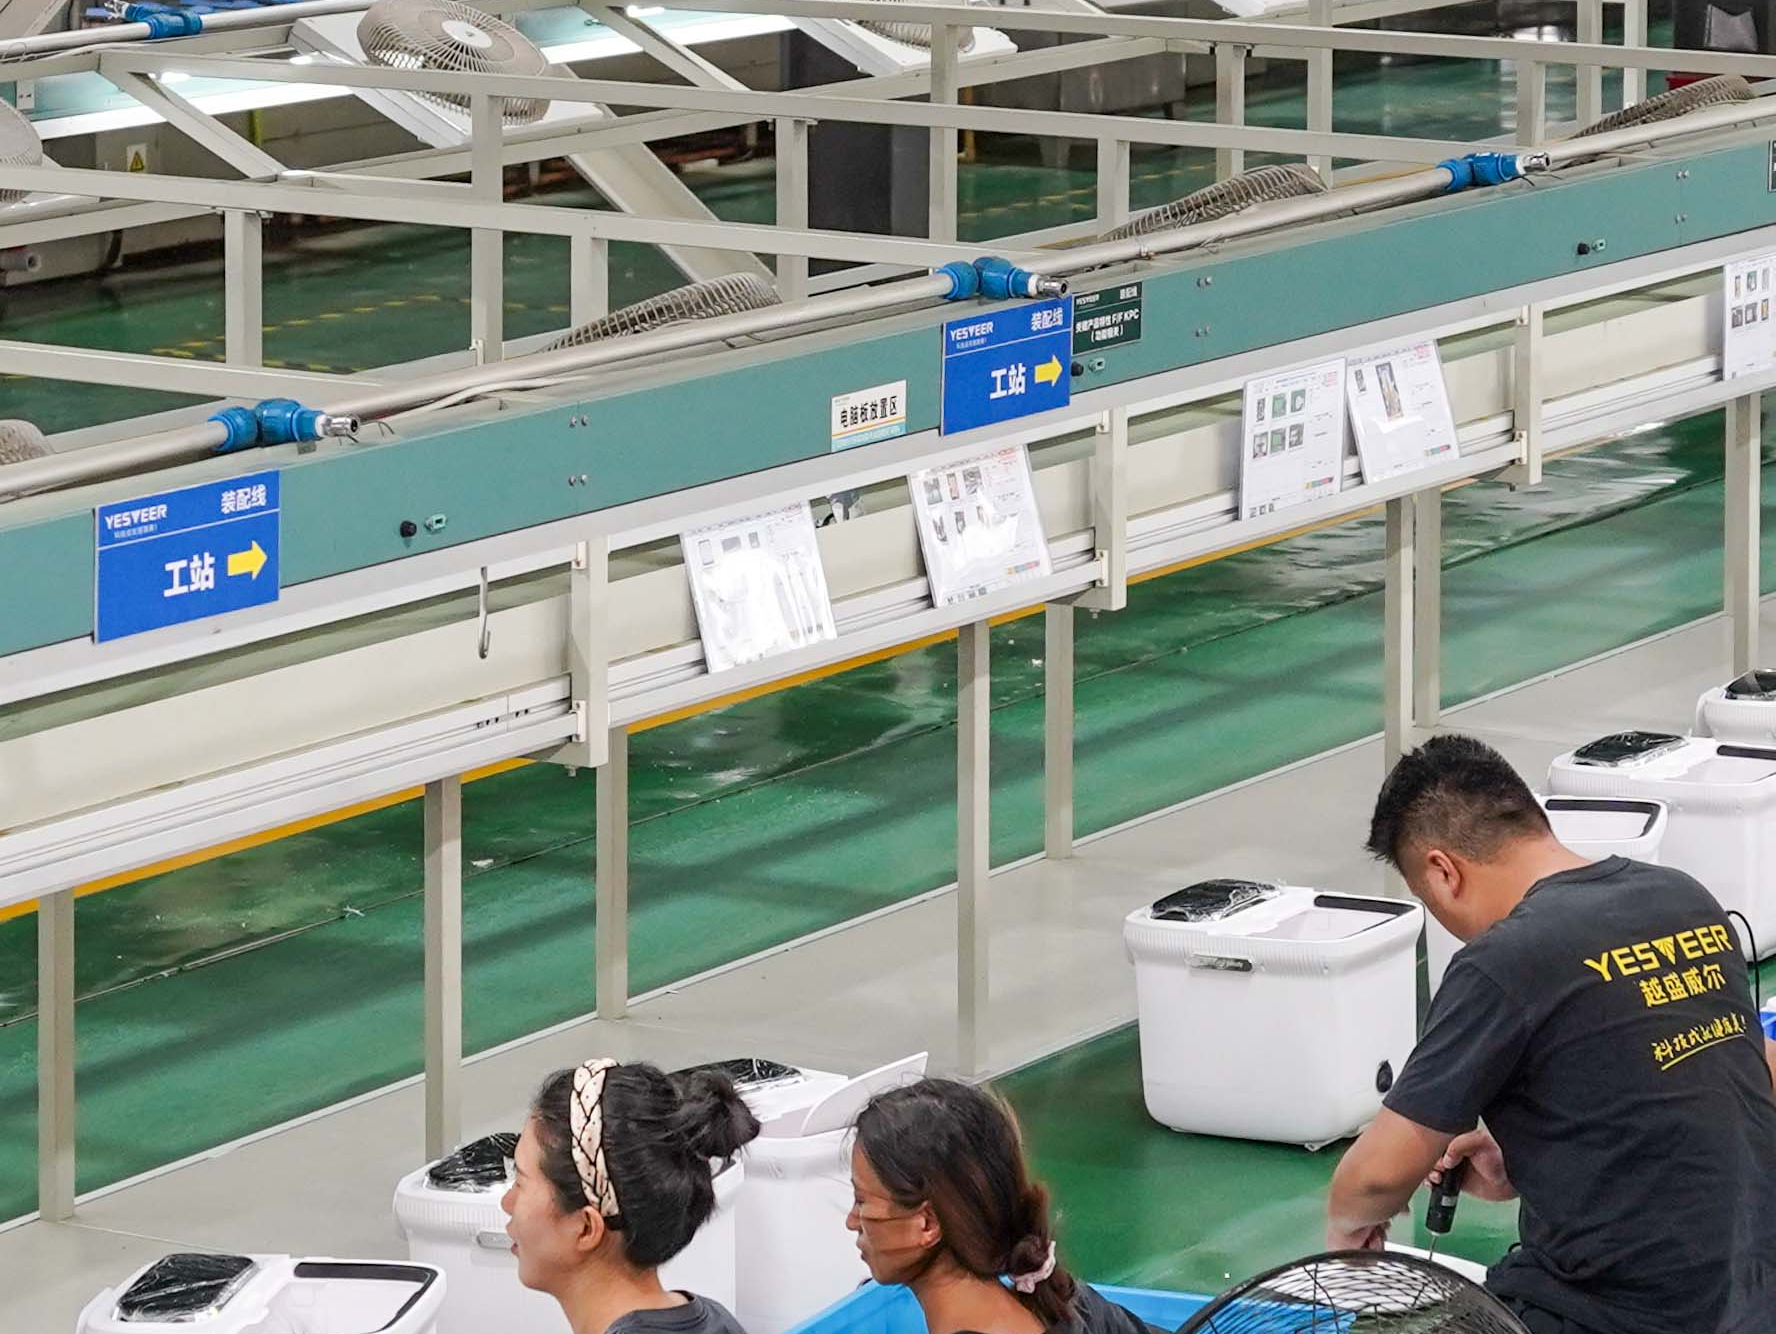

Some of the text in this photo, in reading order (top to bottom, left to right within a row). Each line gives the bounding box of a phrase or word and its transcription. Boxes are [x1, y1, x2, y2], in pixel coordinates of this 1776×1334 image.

[949, 320, 995, 342] YESVEER
[1030, 306, 1064, 332] 装配线
[988, 363, 1027, 401] 工站
[840, 394, 899, 428] 电脑板放置区
[104, 503, 169, 531] YESVEER
[220, 484, 267, 516] 装配线
[163, 551, 217, 599] 工站
[1583, 923, 1735, 983] YESVEER
[1638, 963, 1727, 1008] 越盛威尔
